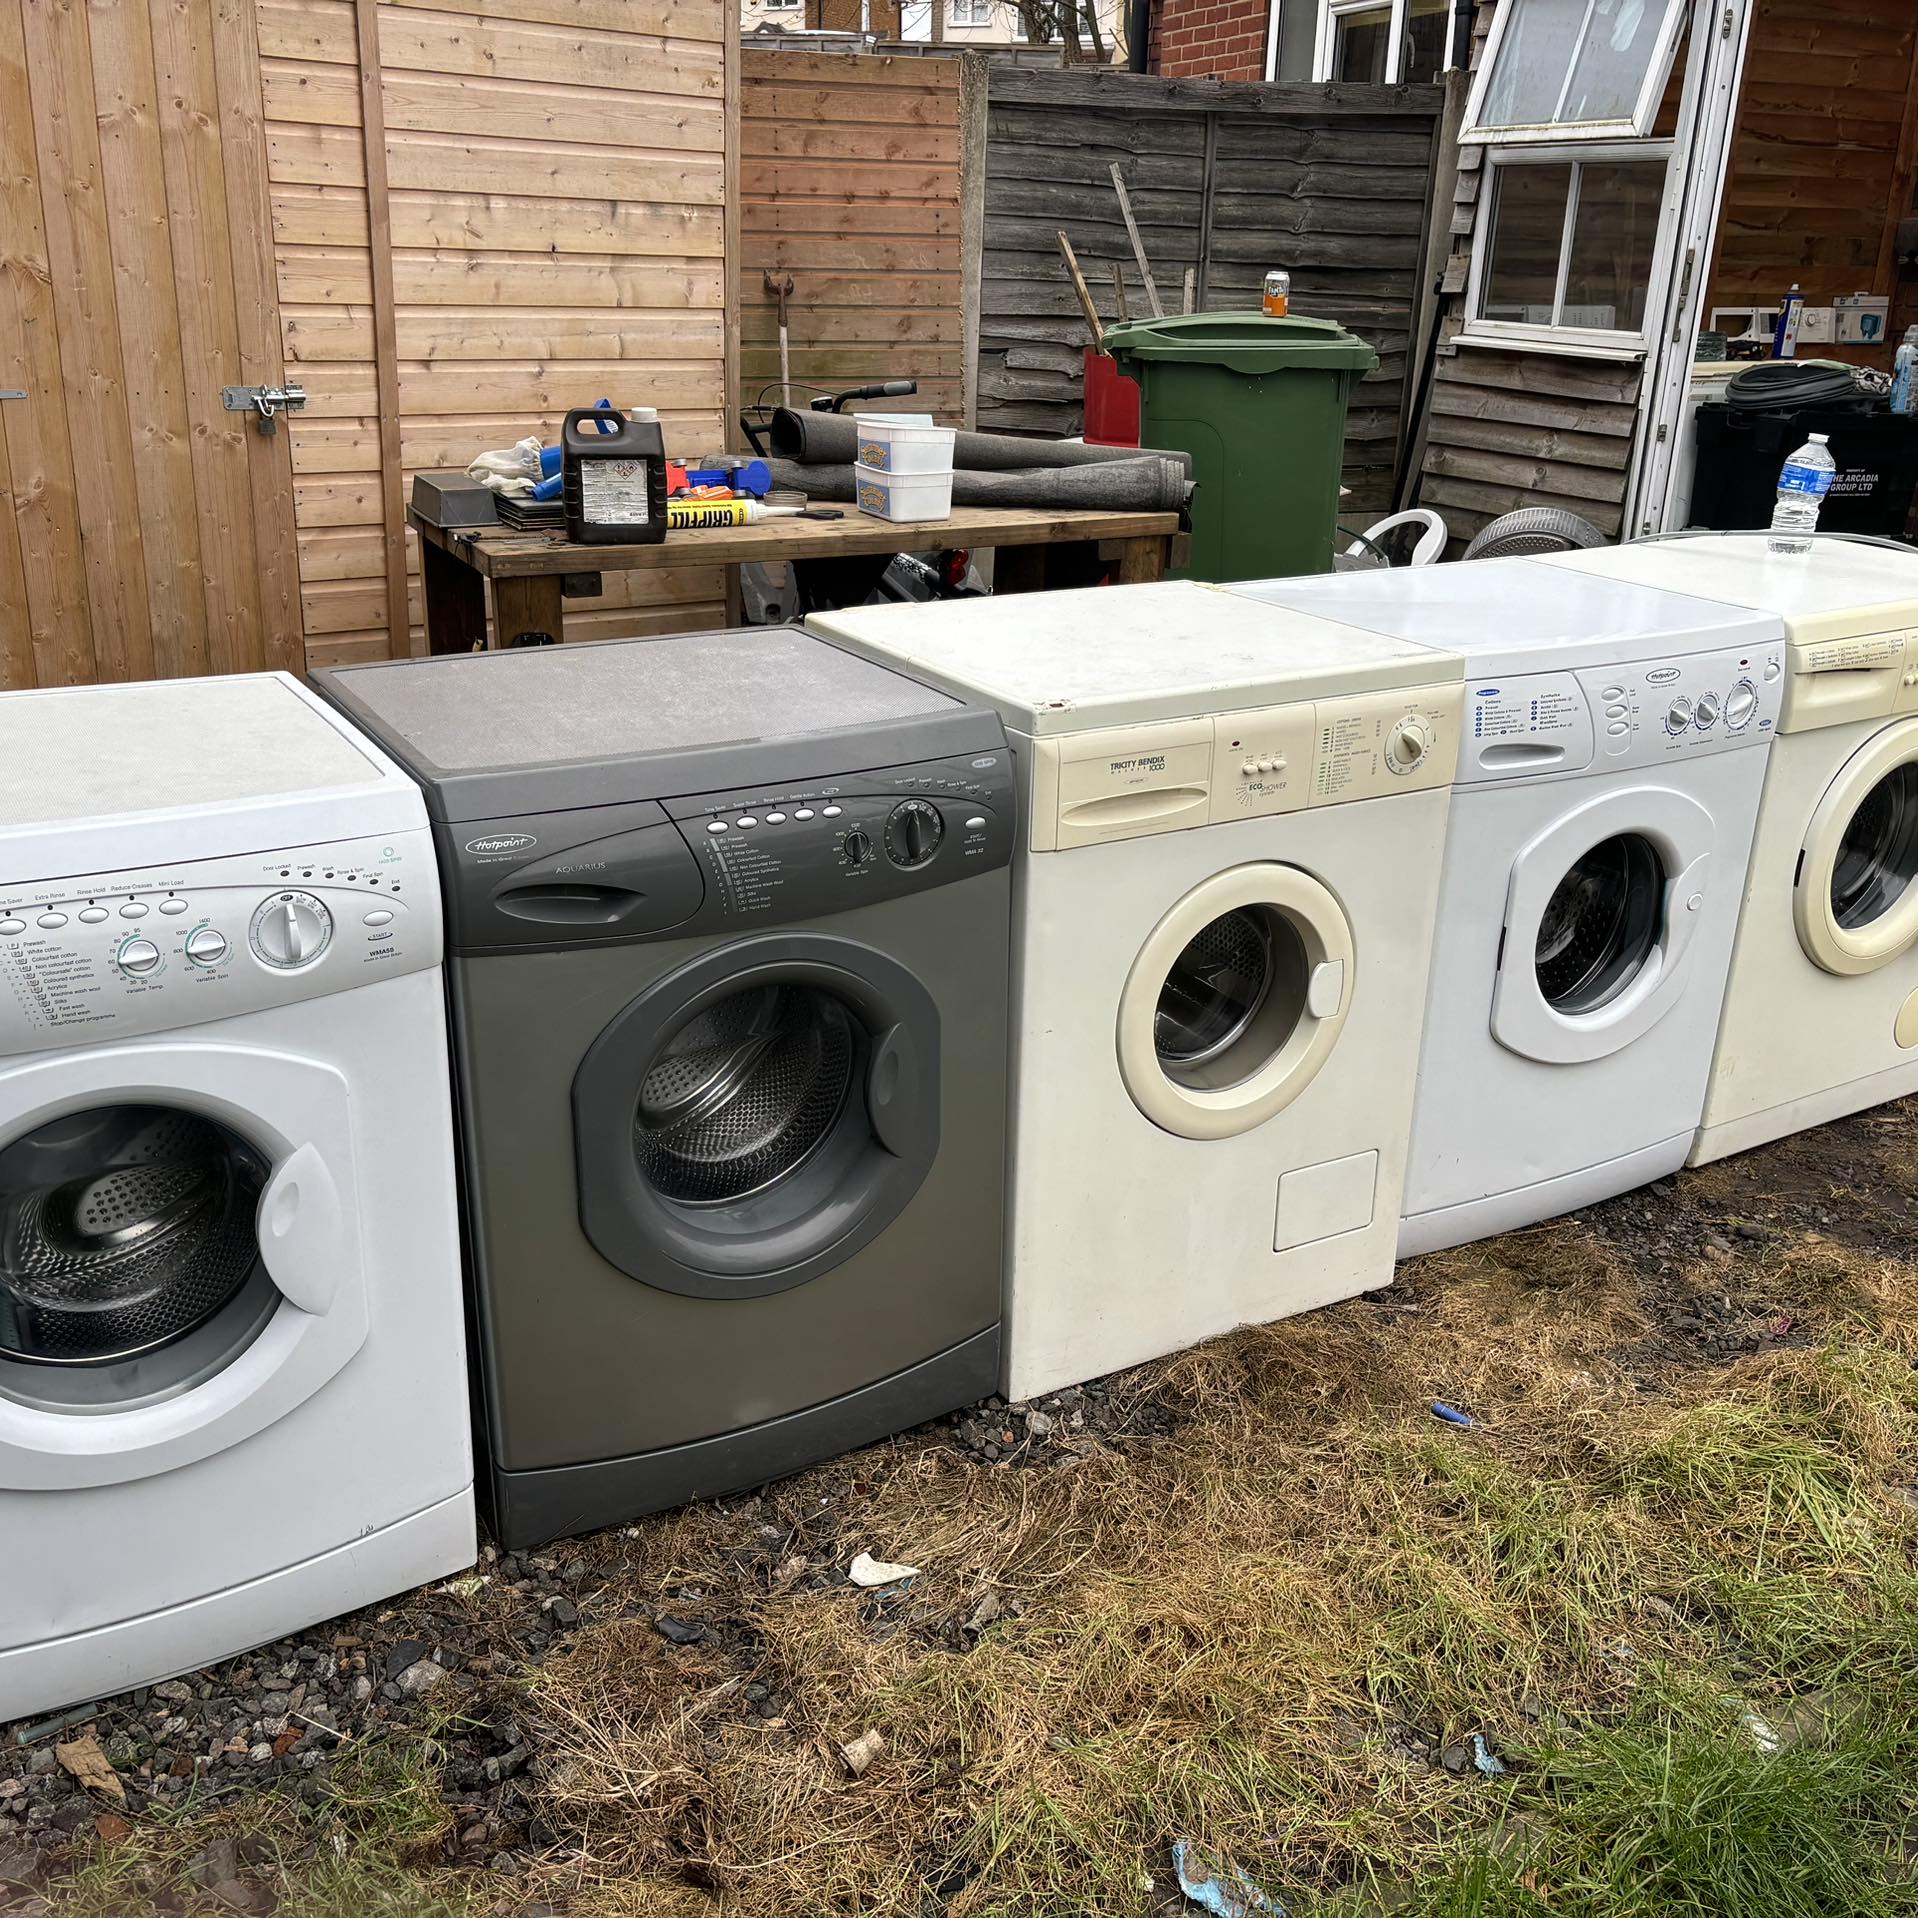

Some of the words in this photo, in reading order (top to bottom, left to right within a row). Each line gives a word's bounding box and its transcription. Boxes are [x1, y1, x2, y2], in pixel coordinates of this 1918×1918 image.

[1833, 474, 1844, 482] HE
[1845, 474, 1879, 482] ARCADIA
[1830, 483, 1857, 491] GROUP
[1858, 483, 1873, 491] LTD
[671, 509, 733, 528] GRIPFILL
[1651, 671, 1676, 680] Hotpoint
[1110, 760, 1137, 771] TRICITY
[1138, 756, 1165, 767] BENDIX
[1149, 763, 1166, 772] 1000
[1249, 783, 1263, 791] ECO
[474, 837, 528, 851] Hotpoint
[555, 862, 606, 874] AQUARIUS
[110, 884, 130, 892] Reduce
[130, 882, 153, 890] Creases
[23, 939, 46, 947] Prewash
[27, 947, 48, 955] White
[31, 954, 60, 962] Colourfast
[49, 959, 75, 968] colourfast
[43, 976, 69, 984] Coloured
[69, 972, 95, 981] synthetics
[50, 990, 73, 998] Machine
[126, 987, 146, 995] Variable
[50, 1018, 86, 1027] Stop/Change
[86, 1013, 116, 1023] programme
